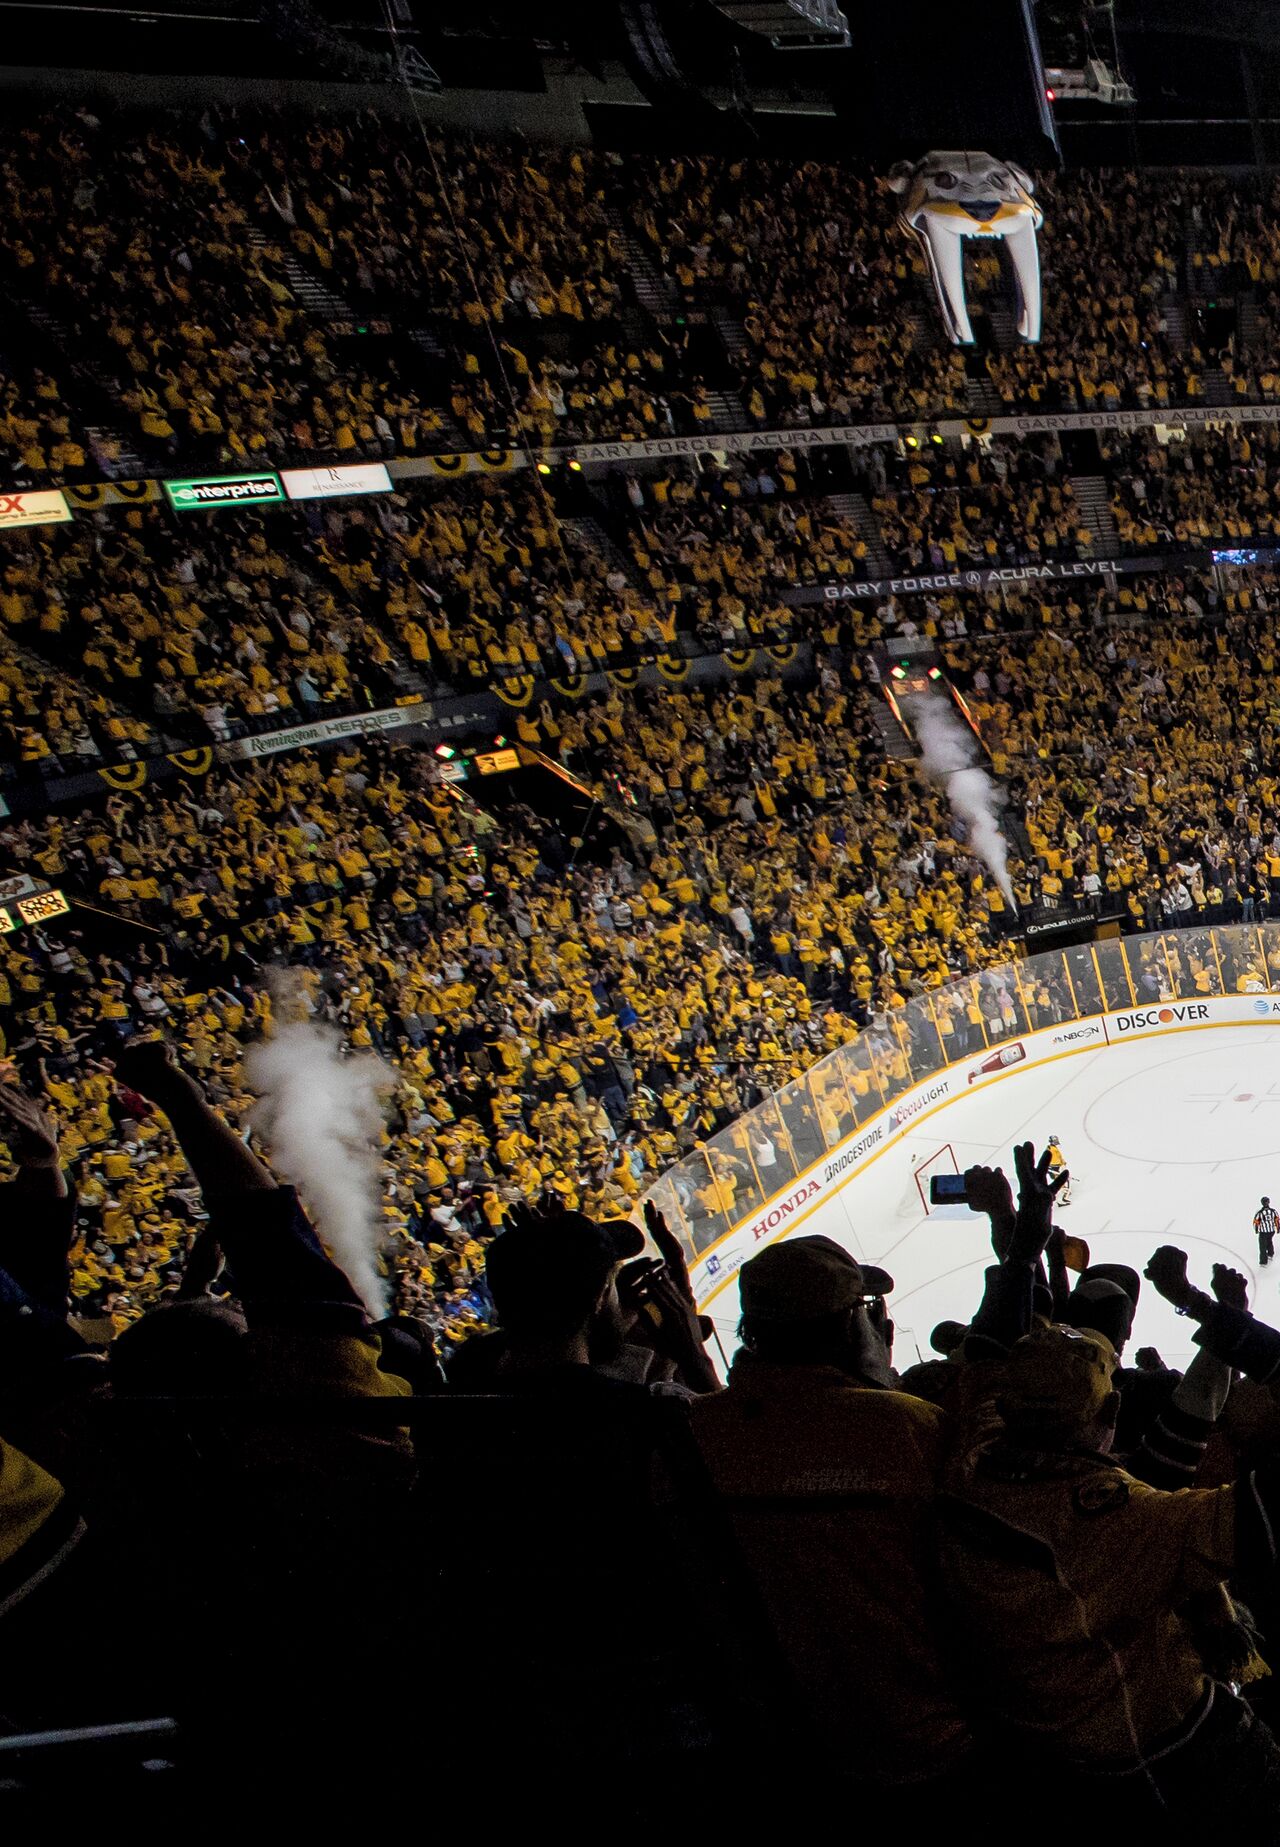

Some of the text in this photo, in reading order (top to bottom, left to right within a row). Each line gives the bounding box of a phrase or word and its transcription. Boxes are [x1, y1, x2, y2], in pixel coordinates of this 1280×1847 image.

[1018, 417, 1068, 431] GARY
[1078, 413, 1144, 427] FORCE
[644, 437, 720, 456] FORCE
[750, 431, 823, 447] ACURA
[178, 479, 278, 503] enterprise
[824, 561, 1124, 600] GARY FORCE ACURA LEVEL
[250, 712, 402, 754] Remington HEROES
[1067, 914, 1095, 925] LOUNGE
[1117, 1005, 1209, 1032] DISCOVER
[893, 1081, 950, 1126] Coors LIGHT
[824, 1126, 884, 1184] BRIDGESTONE
[751, 1180, 822, 1242] HONDA
